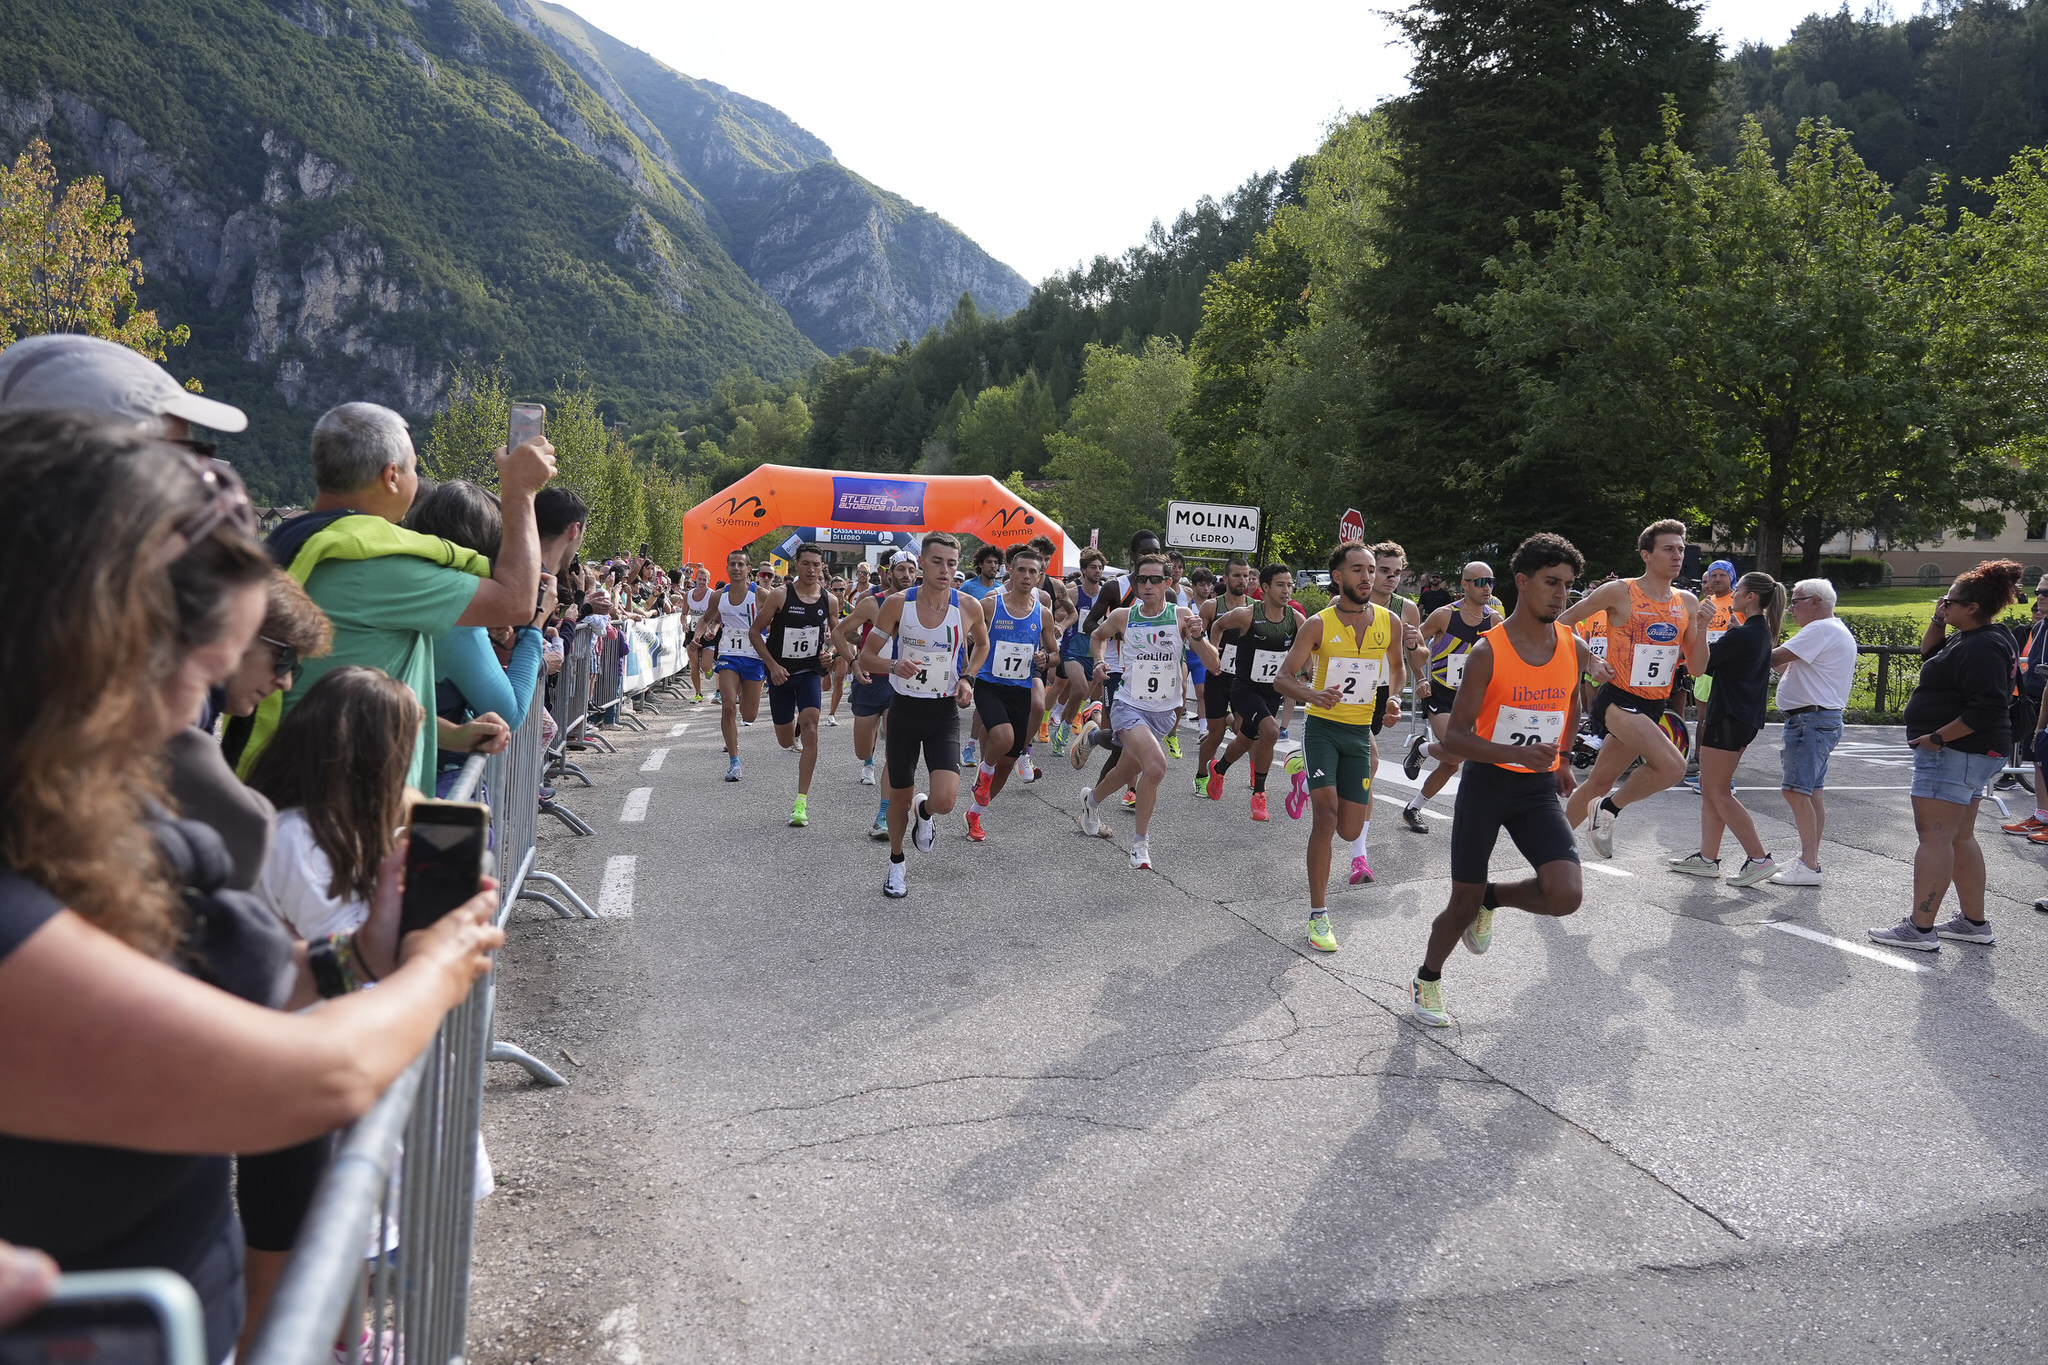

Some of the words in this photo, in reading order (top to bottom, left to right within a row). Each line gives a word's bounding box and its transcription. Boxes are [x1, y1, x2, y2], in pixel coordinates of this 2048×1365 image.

[716, 517, 760, 527] syemme
[1175, 510, 1250, 530] MOLINA
[991, 527, 1033, 538] syemme
[1190, 532, 1234, 545] (LEDRO)
[1341, 521, 1363, 542] STOP
[730, 638, 743, 650] 11
[792, 640, 809, 653] 16
[1003, 656, 1023, 672] 17
[1262, 663, 1278, 677] 12
[1647, 662, 1660, 678] 5
[915, 669, 928, 684] 4
[1147, 677, 1159, 693] 9
[1342, 677, 1357, 695] 2
[1513, 686, 1566, 701] libertas
